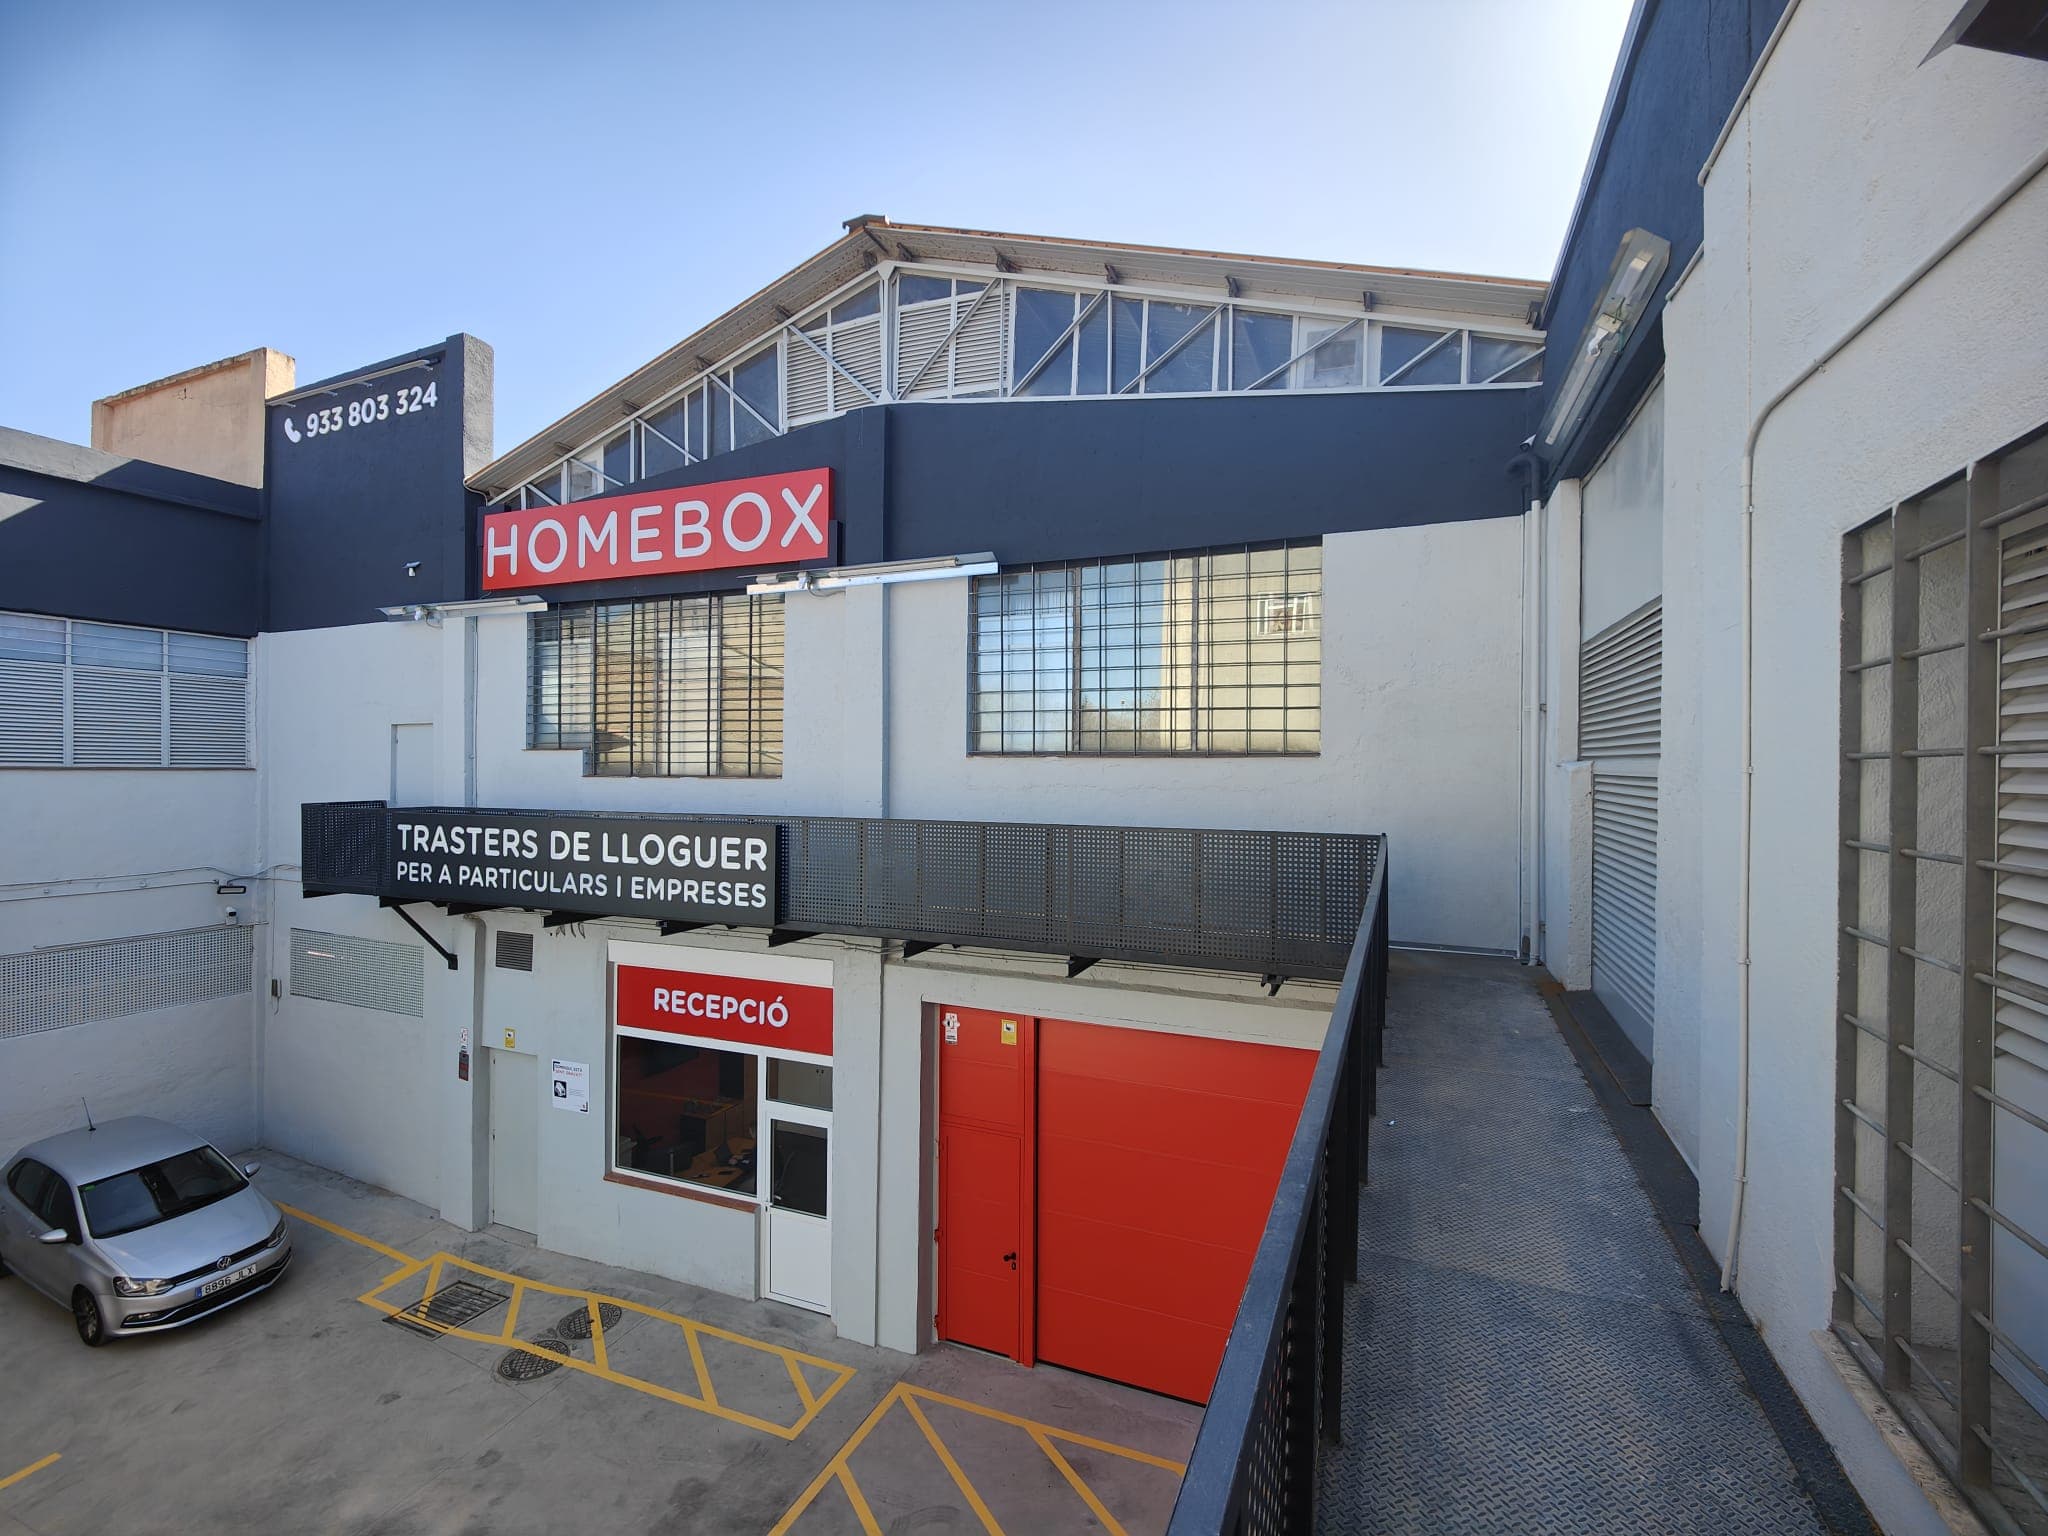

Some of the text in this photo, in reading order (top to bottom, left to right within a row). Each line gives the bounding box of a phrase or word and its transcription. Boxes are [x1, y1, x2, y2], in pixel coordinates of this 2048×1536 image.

[306, 381, 438, 438] 933 803 324
[487, 483, 824, 578] HOMEBOX
[397, 824, 768, 872] TRASTERS DE LLOGUER
[397, 861, 767, 908] PER A PARTICULARS I EMPRESES
[654, 987, 789, 1028] RECEPCIÓ
[205, 1276, 232, 1293] 8896
